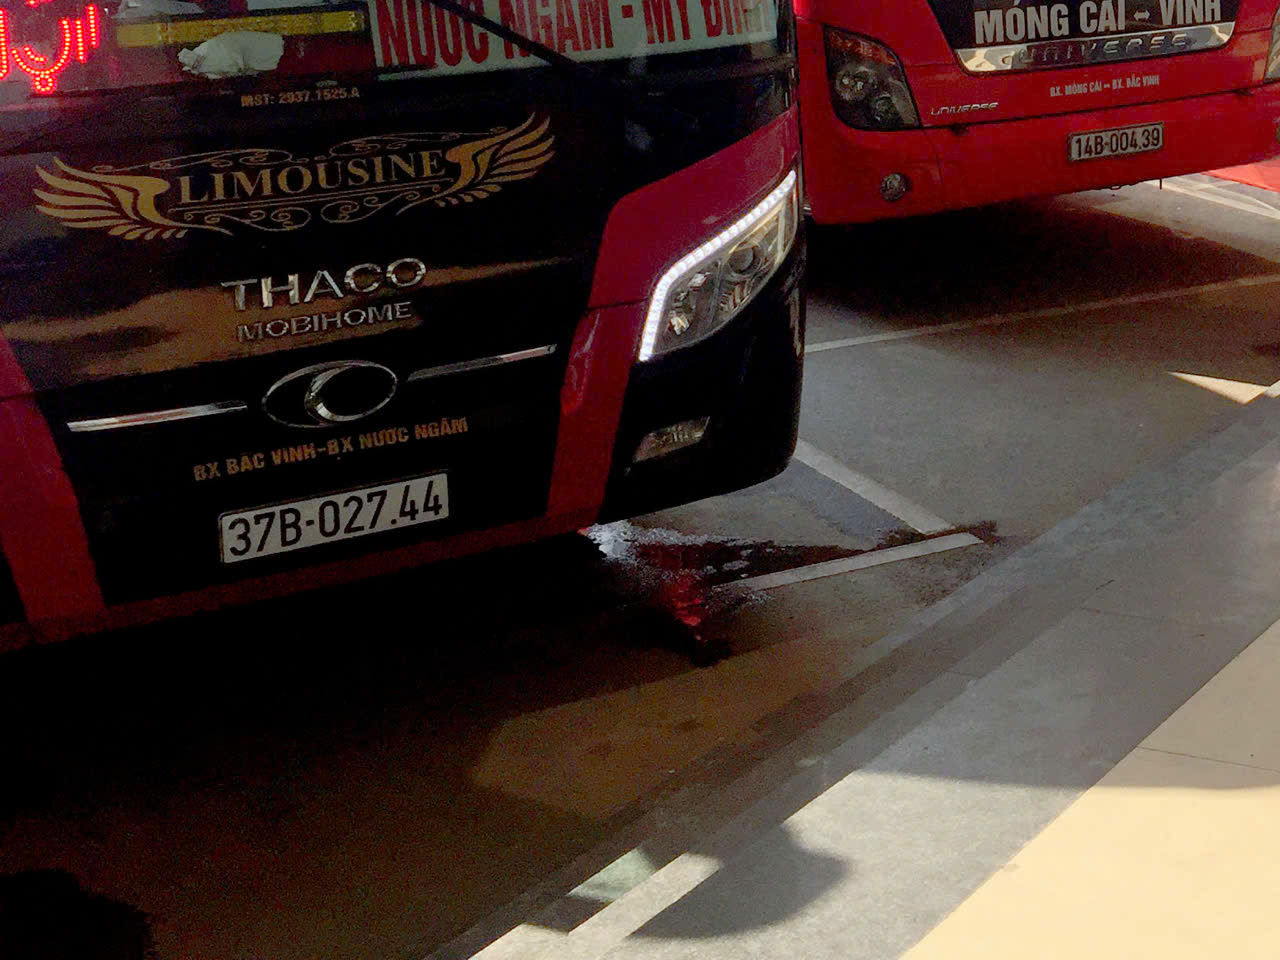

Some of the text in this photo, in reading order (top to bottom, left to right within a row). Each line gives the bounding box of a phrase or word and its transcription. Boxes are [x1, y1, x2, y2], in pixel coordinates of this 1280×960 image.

[1019, 33, 1188, 63] UNIVERSE
[930, 102, 999, 116] UNIVERSE
[1075, 126, 1160, 159] 14B-004.39
[176, 150, 446, 205] LIMOUSINE
[220, 257, 427, 311] THACO
[237, 301, 413, 342] MOBIHOME
[193, 460, 221, 481] BX
[228, 480, 443, 557] 37B-027.44
